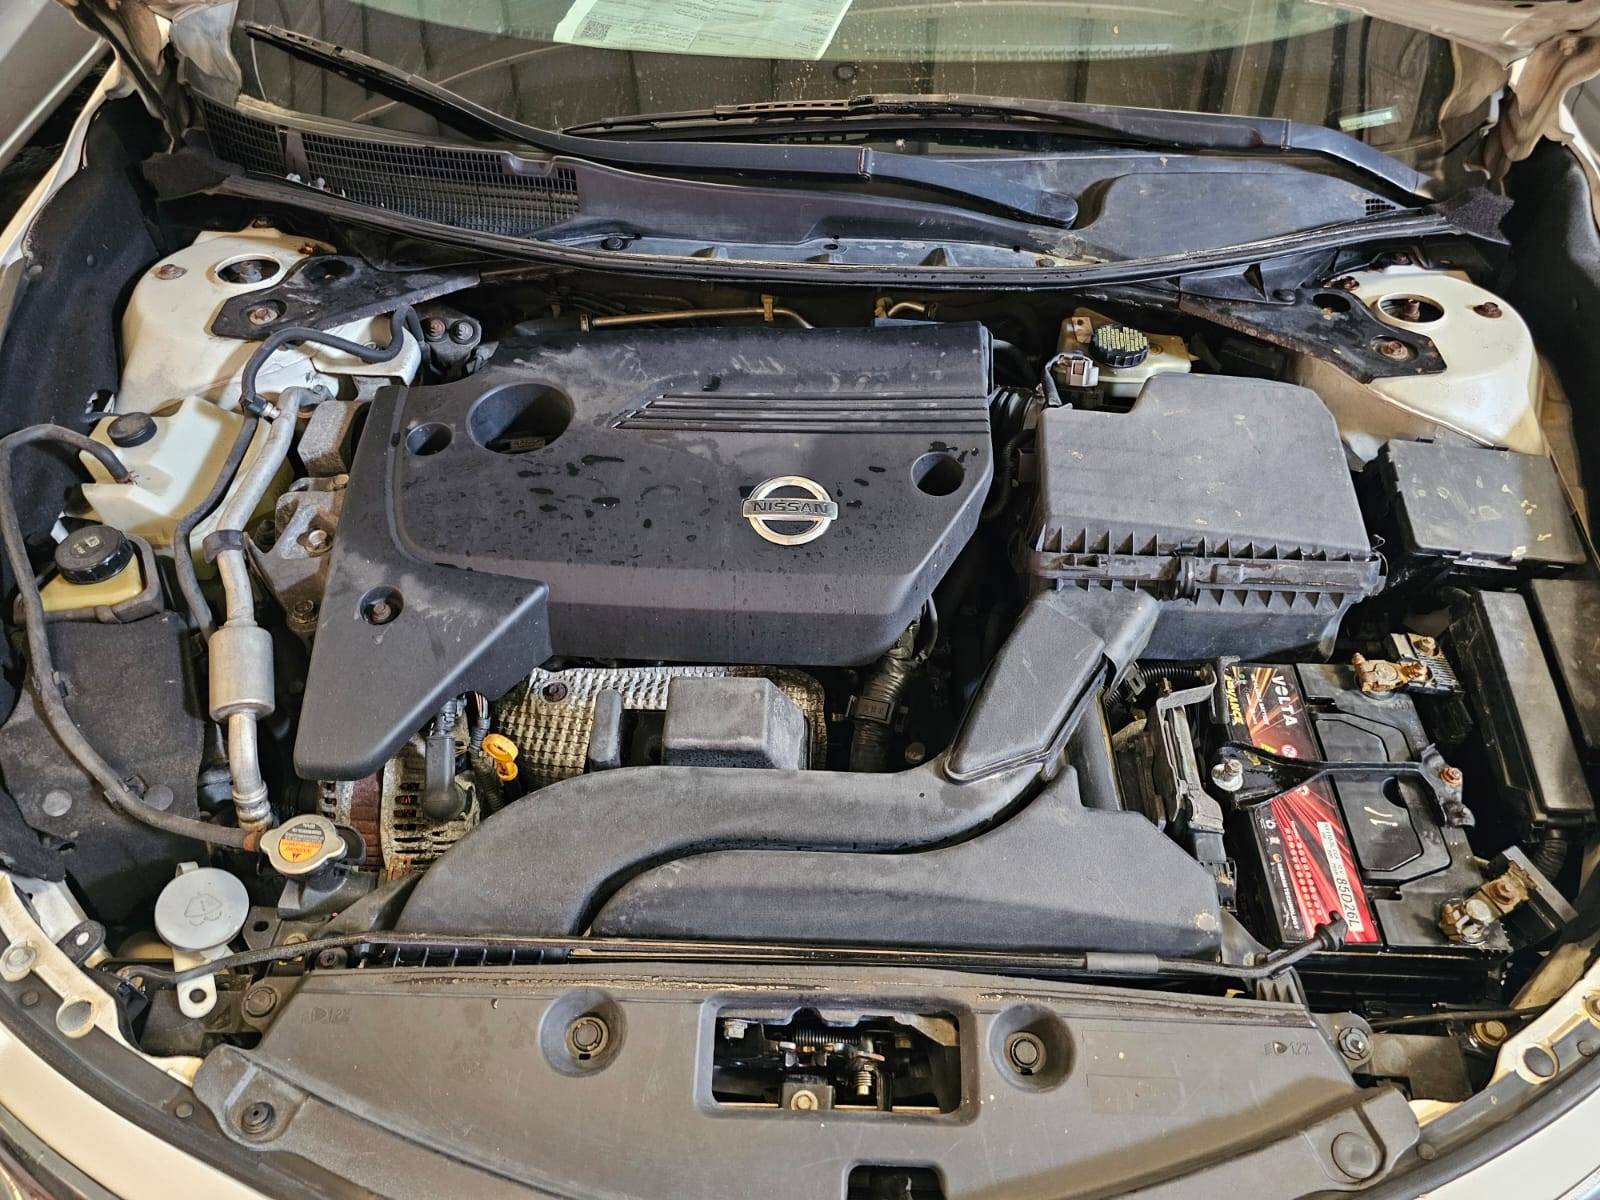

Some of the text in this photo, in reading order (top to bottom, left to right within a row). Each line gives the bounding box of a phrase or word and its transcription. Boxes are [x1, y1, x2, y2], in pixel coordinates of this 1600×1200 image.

[753, 502, 828, 514] NISSAN
[1272, 675, 1298, 726] VOLTA
[1336, 877, 1360, 927] 85D26L
